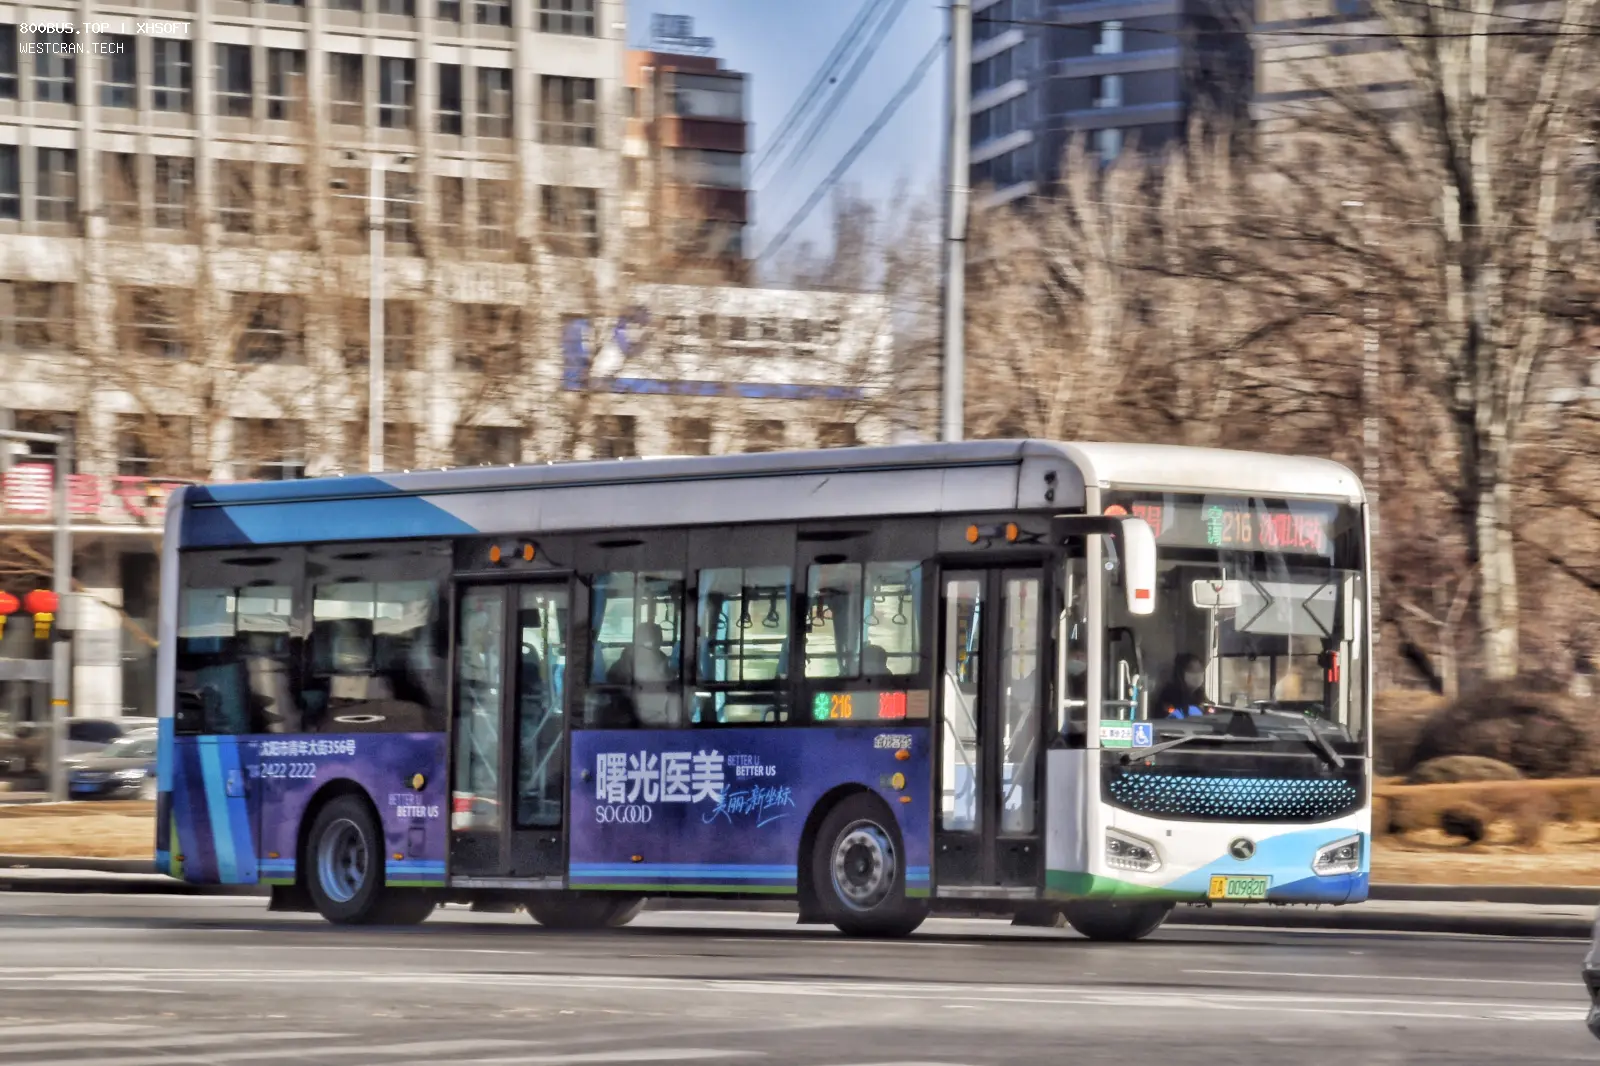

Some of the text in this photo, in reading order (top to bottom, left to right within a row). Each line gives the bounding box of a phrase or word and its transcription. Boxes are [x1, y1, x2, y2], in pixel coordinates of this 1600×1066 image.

[1223, 511, 1252, 543] 216
[830, 693, 853, 719] 216
[727, 754, 753, 767] BETTER
[260, 762, 287, 779] 2422
[288, 762, 317, 778] 2222
[595, 749, 725, 804] 曙光医美
[735, 765, 777, 777] BETTER US
[396, 805, 440, 818] BETTER US
[595, 804, 653, 824] SOGOOD
